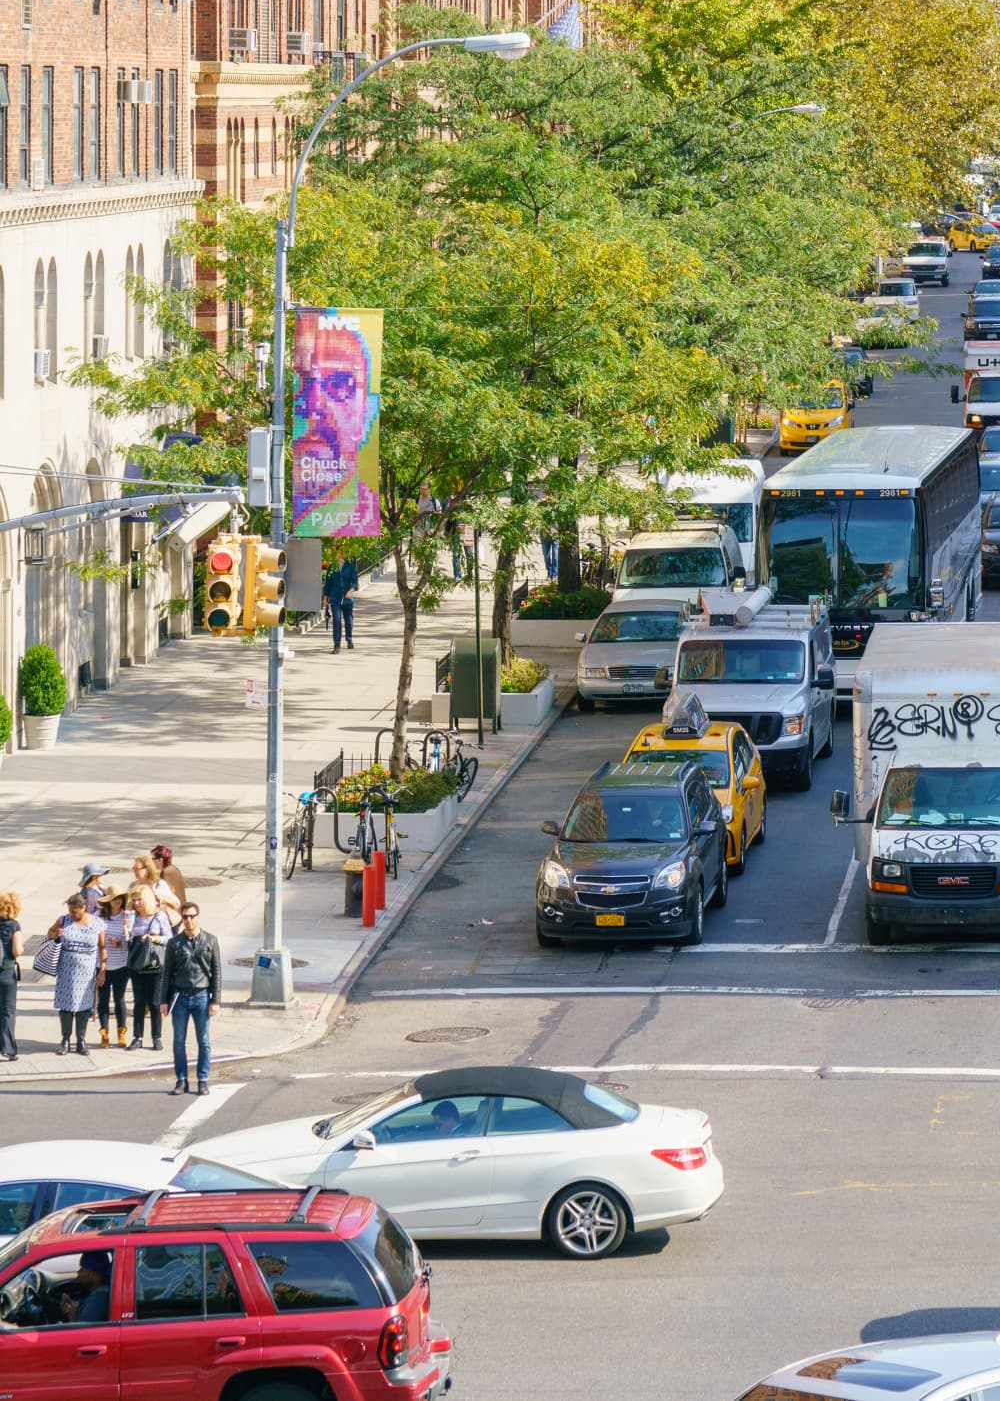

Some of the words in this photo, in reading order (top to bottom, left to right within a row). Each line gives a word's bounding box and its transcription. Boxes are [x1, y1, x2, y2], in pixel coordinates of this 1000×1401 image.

[318, 316, 360, 331] NYC
[301, 455, 347, 470] Chuck
[301, 469, 342, 482] Close
[880, 489, 900, 497] 2981
[312, 512, 361, 527] PACE
[937, 876, 970, 885] GMC
